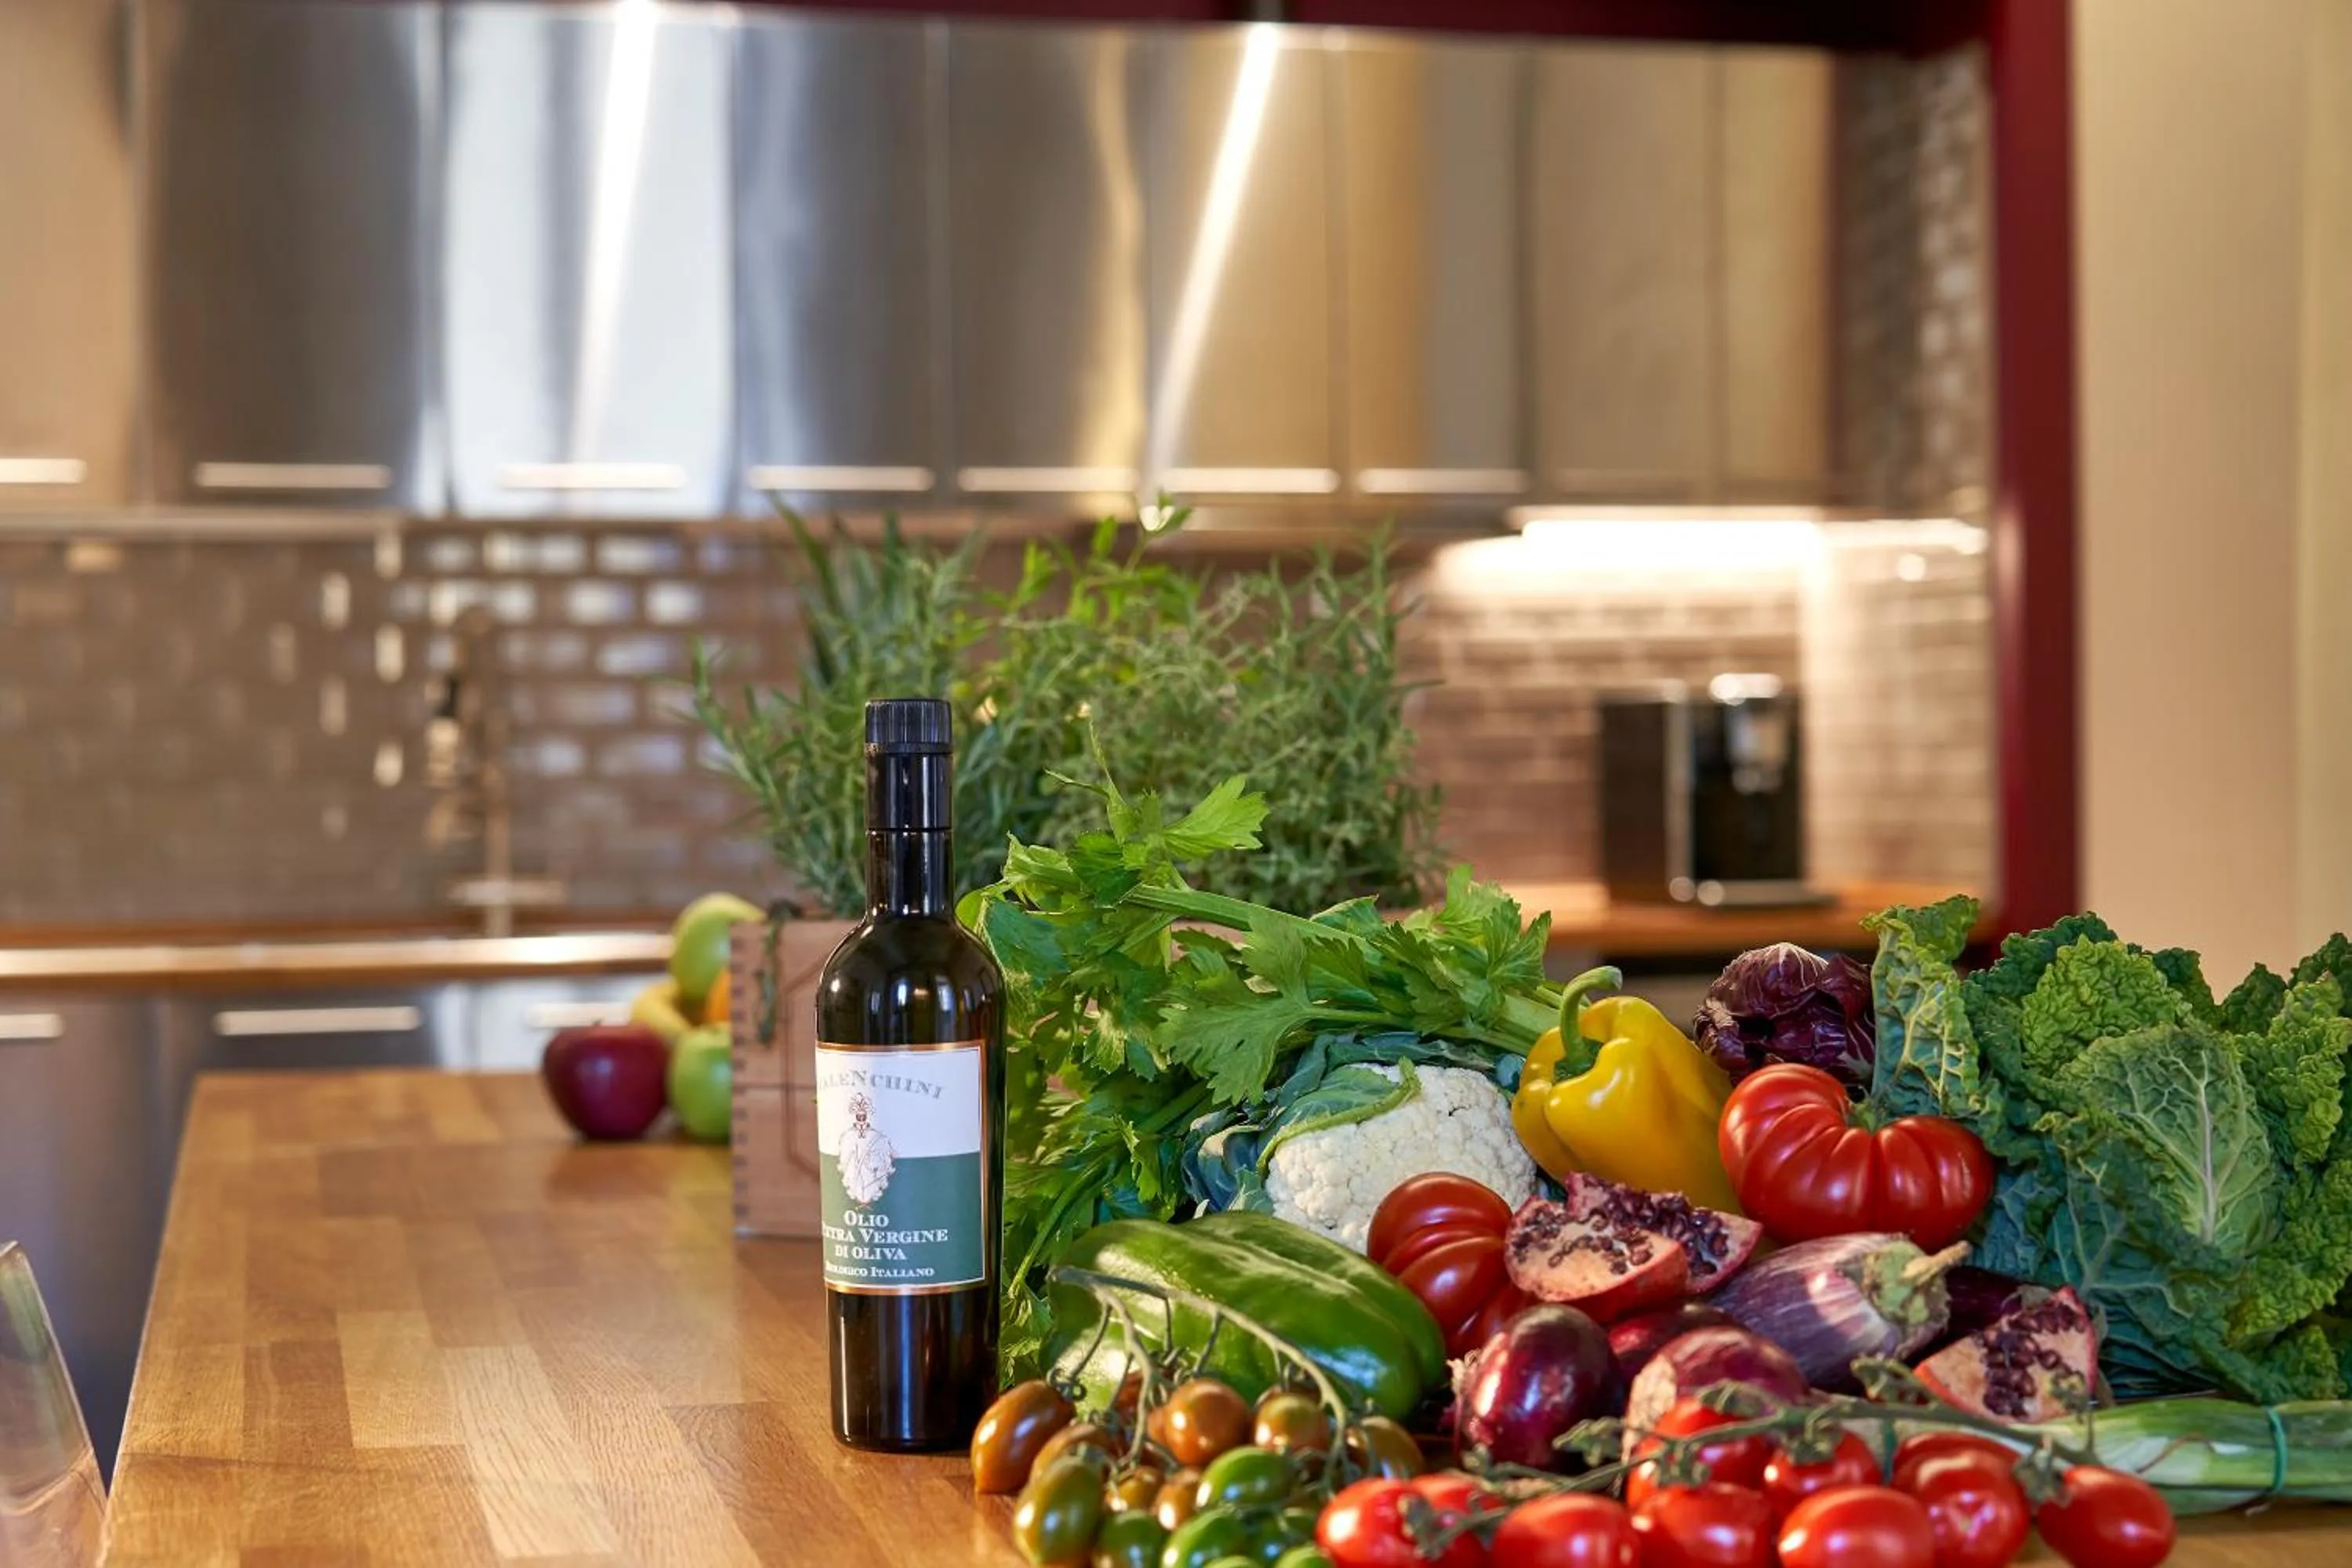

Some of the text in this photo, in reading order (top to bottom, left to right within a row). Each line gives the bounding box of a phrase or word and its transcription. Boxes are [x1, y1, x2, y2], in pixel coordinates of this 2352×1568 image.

[820, 1069, 942, 1098] ALENCHINI
[844, 1210, 888, 1227] OLIO
[859, 1228, 948, 1243] VERGINE
[835, 1244, 907, 1260] DI OLIVA
[871, 1266, 935, 1277] ITALIANO
